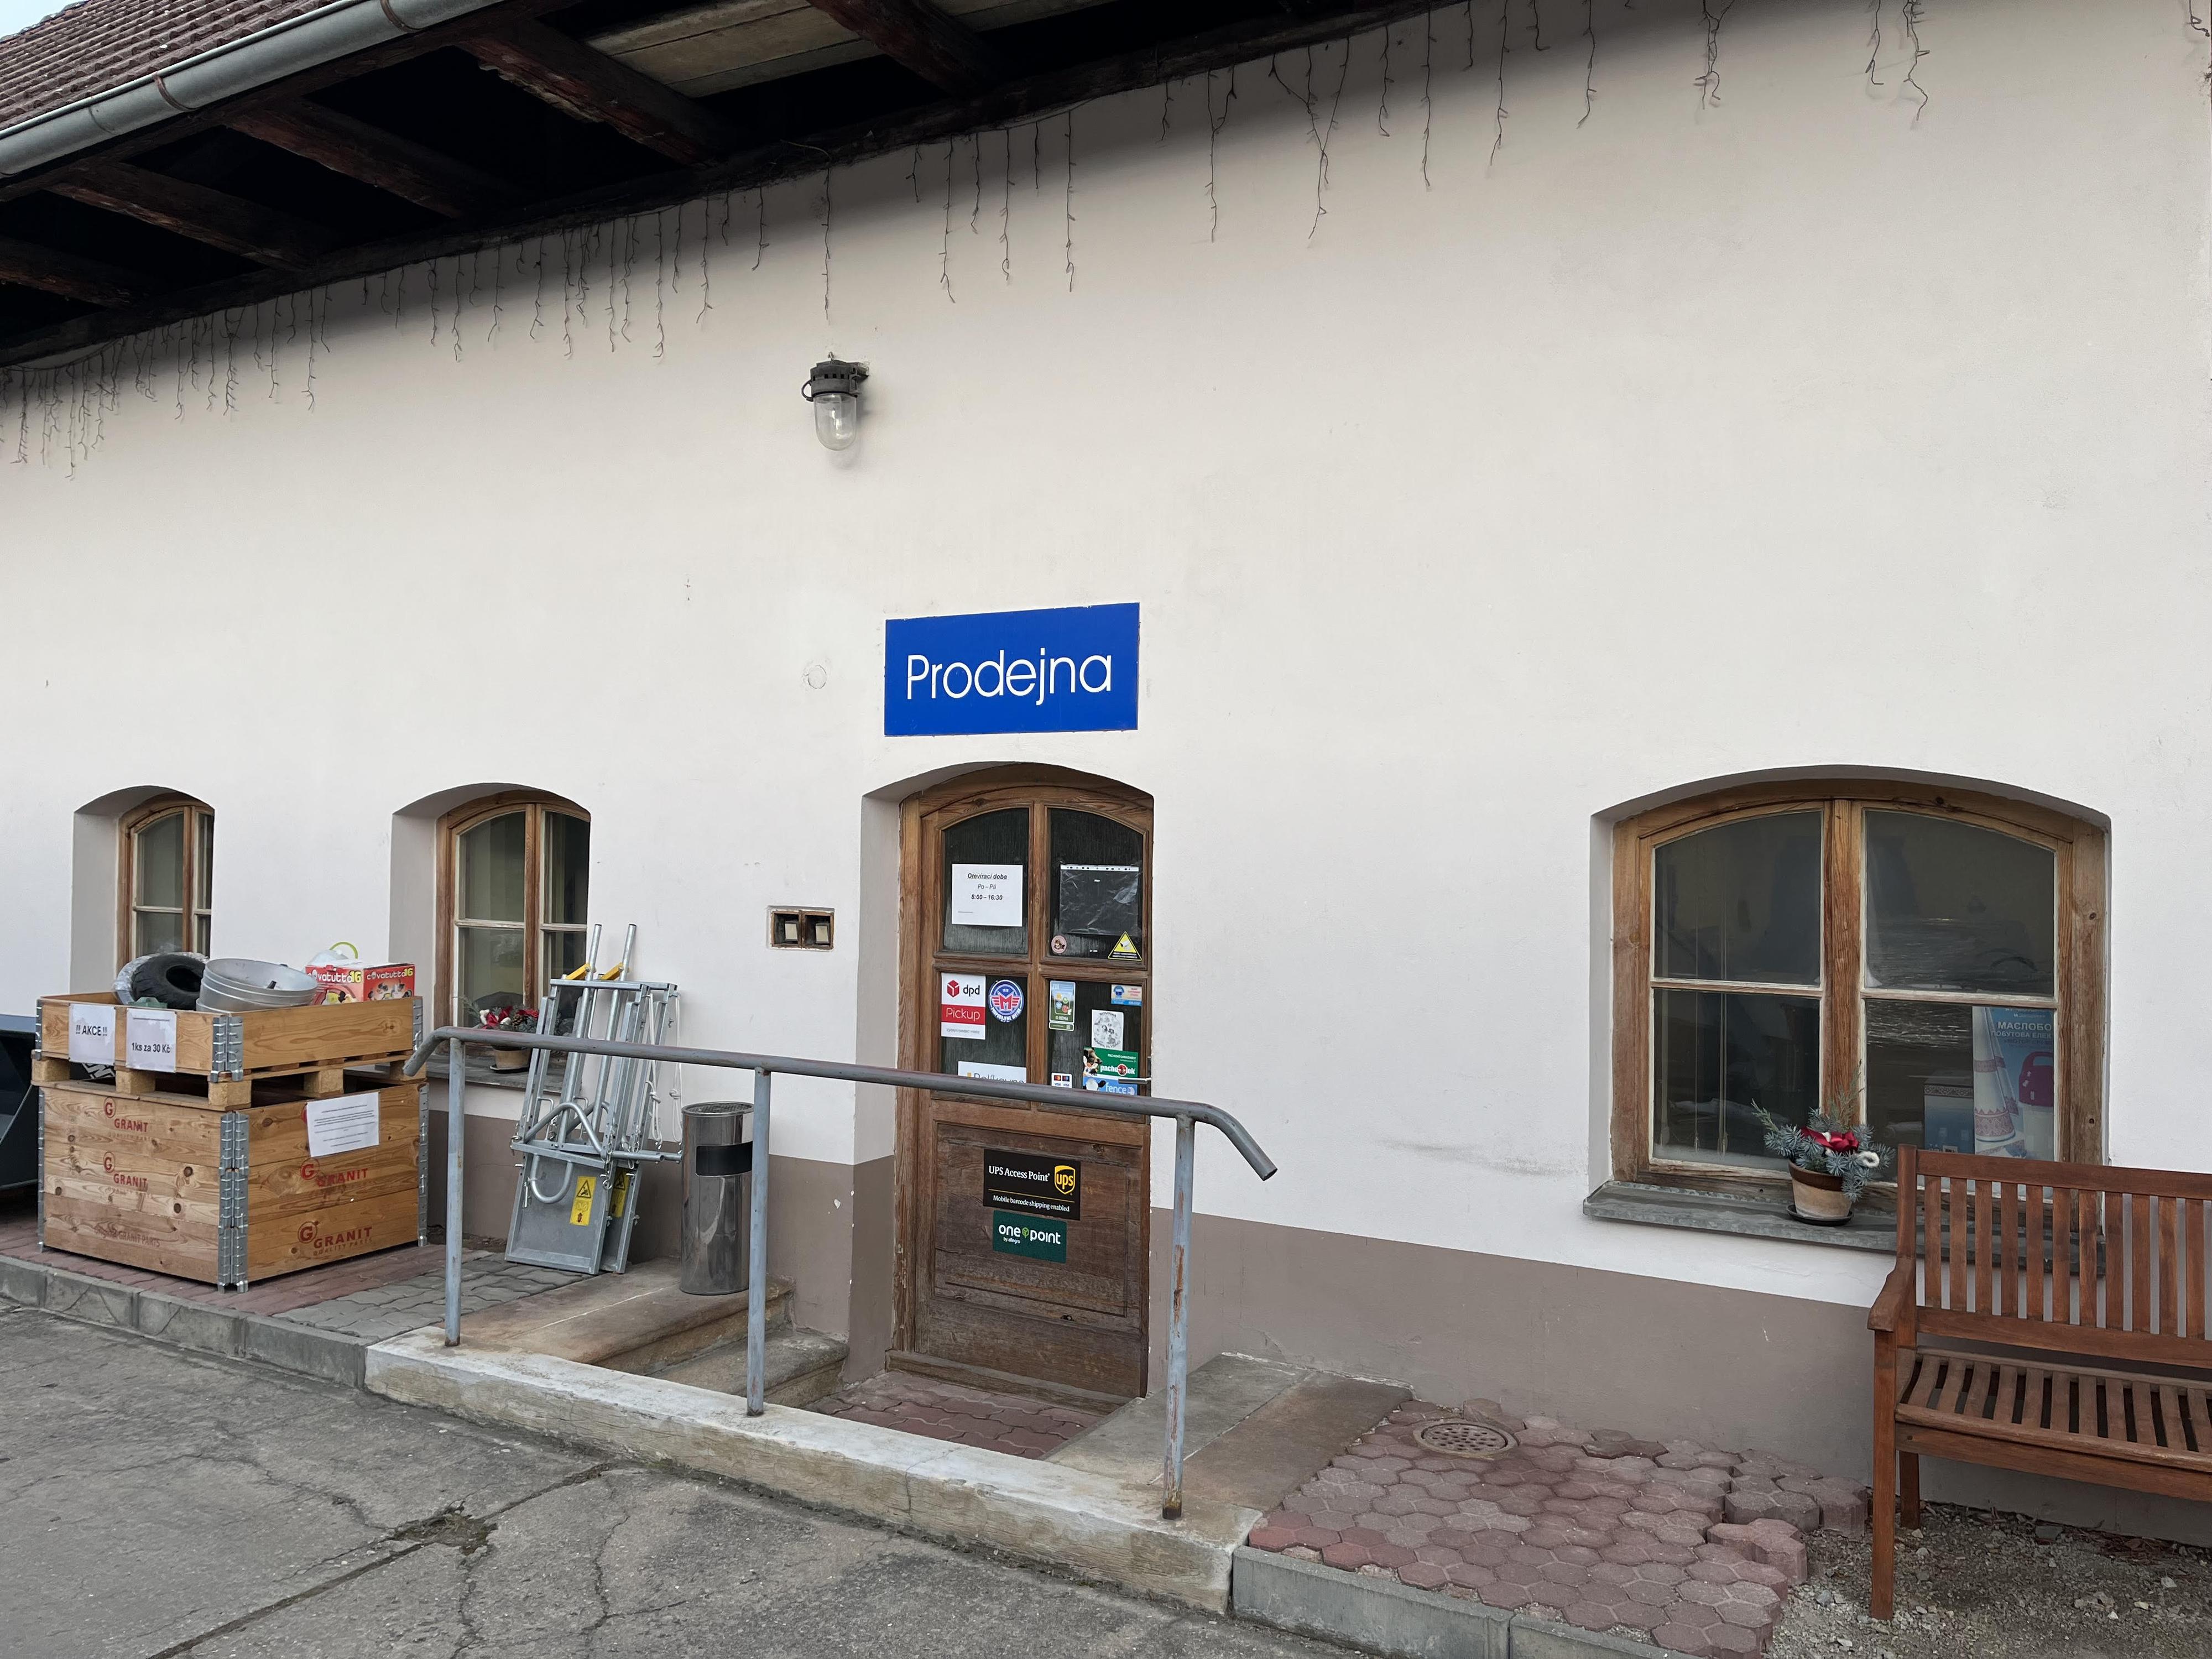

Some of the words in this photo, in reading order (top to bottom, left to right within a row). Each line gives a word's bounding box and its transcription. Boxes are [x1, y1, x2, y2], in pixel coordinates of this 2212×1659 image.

[907, 648, 1112, 706] Prodejna
[963, 984, 980, 997] dpd
[946, 1008, 980, 1022] Pickup
[81, 1026, 101, 1036] AKCE
[1997, 1021, 2052, 1031] МАСЛОБО
[132, 1042, 142, 1051] 1ks
[153, 1044, 160, 1053] 30
[162, 1044, 170, 1053] Kč
[316, 1168, 368, 1187] GRANIT
[989, 1165, 1004, 1175] UPS
[1004, 1168, 1027, 1179] Access
[114, 1173, 147, 1188] GRANIT
[1056, 1173, 1073, 1190] ups
[1010, 1197, 1029, 1206] barcode
[1029, 1199, 1050, 1210] shipping
[1050, 1203, 1070, 1212] enabled
[314, 1227, 372, 1248] GRANIT
[998, 1224, 1021, 1238] one
[1030, 1229, 1061, 1244] point
